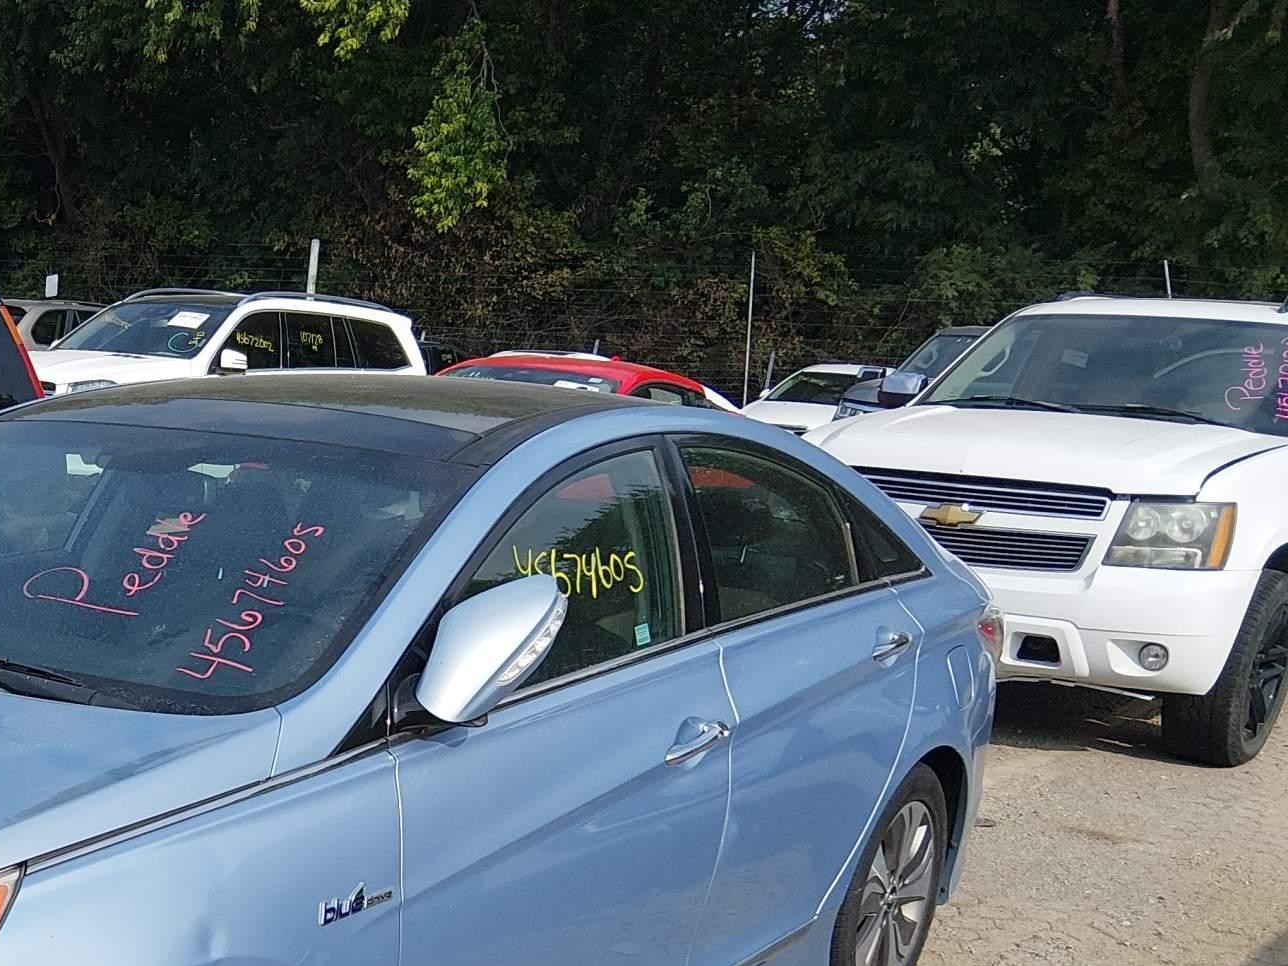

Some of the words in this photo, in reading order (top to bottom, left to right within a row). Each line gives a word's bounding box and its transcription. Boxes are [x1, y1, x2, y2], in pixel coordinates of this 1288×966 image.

[1224, 341, 1267, 411] Peddle
[22, 511, 208, 617] Peddle
[512, 544, 645, 600] 45674605
[175, 521, 325, 680] 45674605
[318, 883, 366, 927] blue
